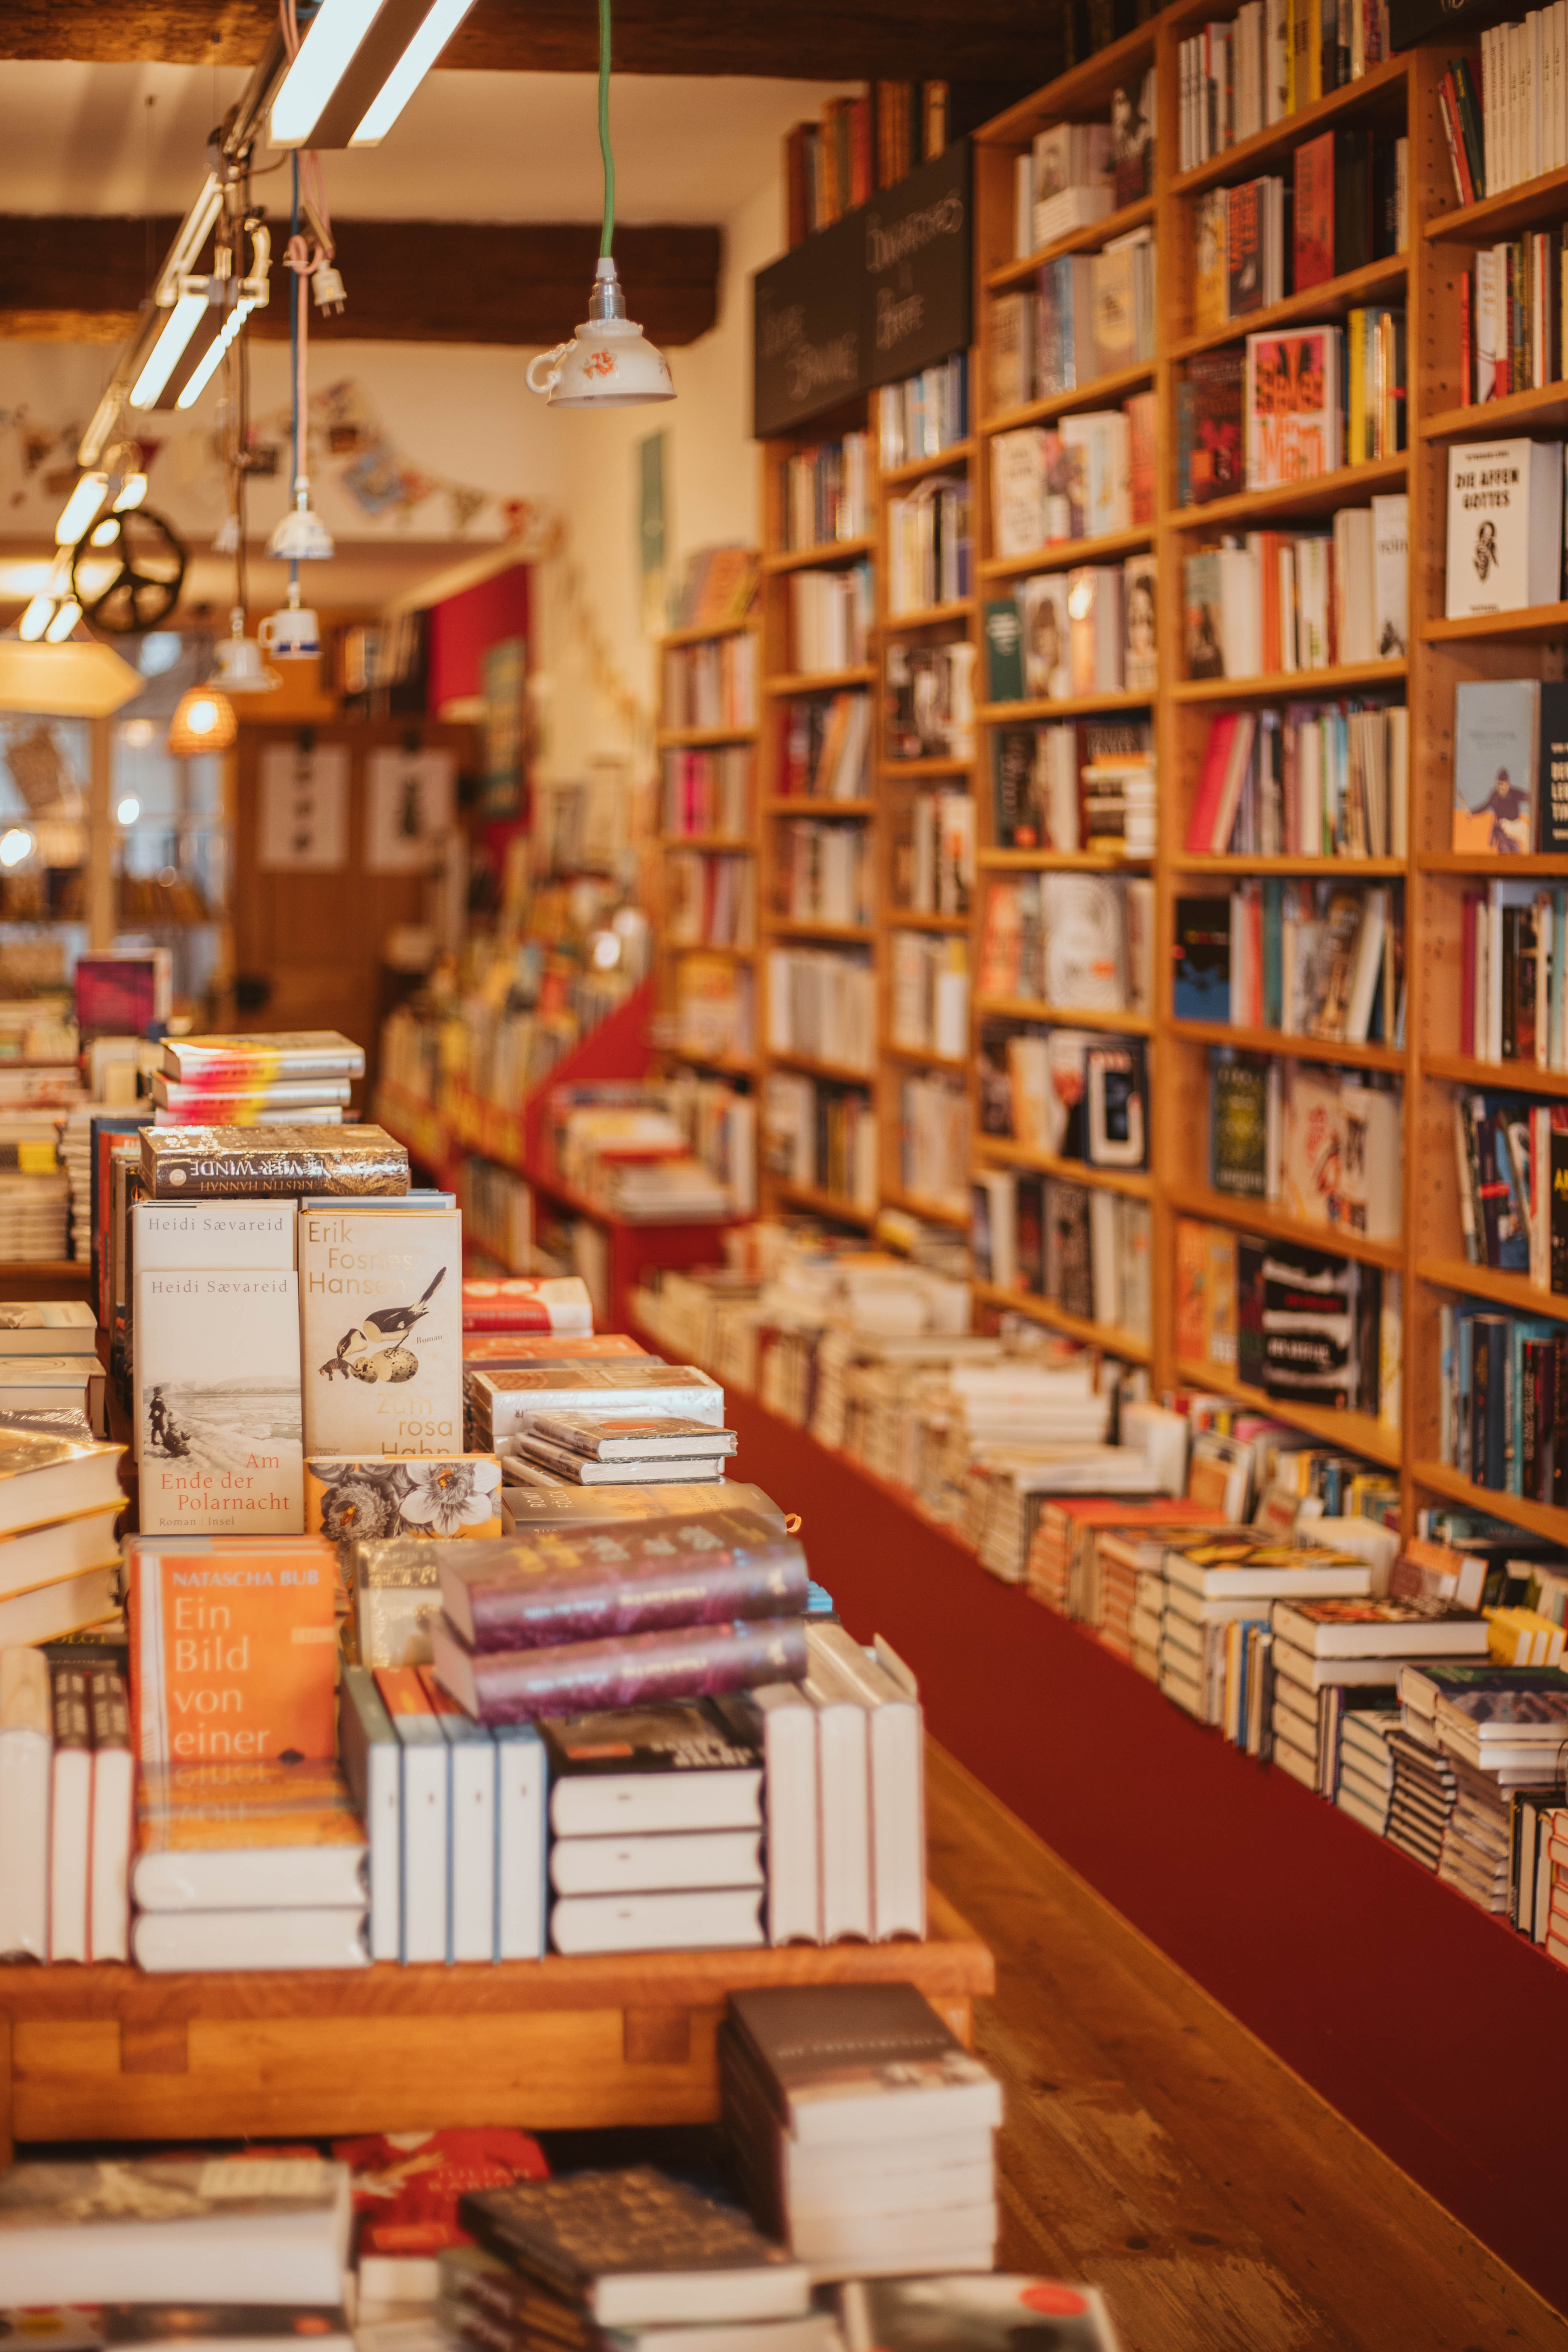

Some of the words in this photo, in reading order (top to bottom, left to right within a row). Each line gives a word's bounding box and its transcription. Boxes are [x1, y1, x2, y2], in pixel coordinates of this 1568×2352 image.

[1456, 472, 1475, 489] DIE
[1479, 467, 1519, 487] AFFEN
[1464, 491, 1510, 510] GOTTES
[190, 1161, 254, 1176] WINDE
[201, 1181, 258, 1191] HANNAH
[263, 1181, 314, 1190] KRISTIN
[148, 1218, 196, 1231] Heidi
[203, 1217, 284, 1231] Sævareid
[308, 1220, 353, 1243] Erik
[329, 1248, 413, 1270] Fosnes
[152, 1280, 199, 1294] Heidi
[207, 1280, 288, 1293] Sævareid
[309, 1272, 406, 1295] Hansen
[416, 1334, 443, 1345] Roman
[378, 1393, 433, 1415] Zum
[398, 1419, 453, 1436] rosa
[246, 1452, 280, 1469] Am
[161, 1472, 213, 1490] Ende
[221, 1472, 254, 1490] der
[178, 1492, 290, 1511] Polarnacht
[521, 1491, 547, 1507] ROMY
[547, 1490, 575, 1508] FÖLCK
[159, 1516, 197, 1527] Roman
[208, 1516, 235, 1527] Insel
[173, 1572, 274, 1586] NATASCHA
[280, 1570, 319, 1586] BUB
[175, 1597, 231, 1631] Ein
[175, 1635, 250, 1672] Bild
[174, 1689, 243, 1713] von
[173, 1724, 270, 1755] einer
